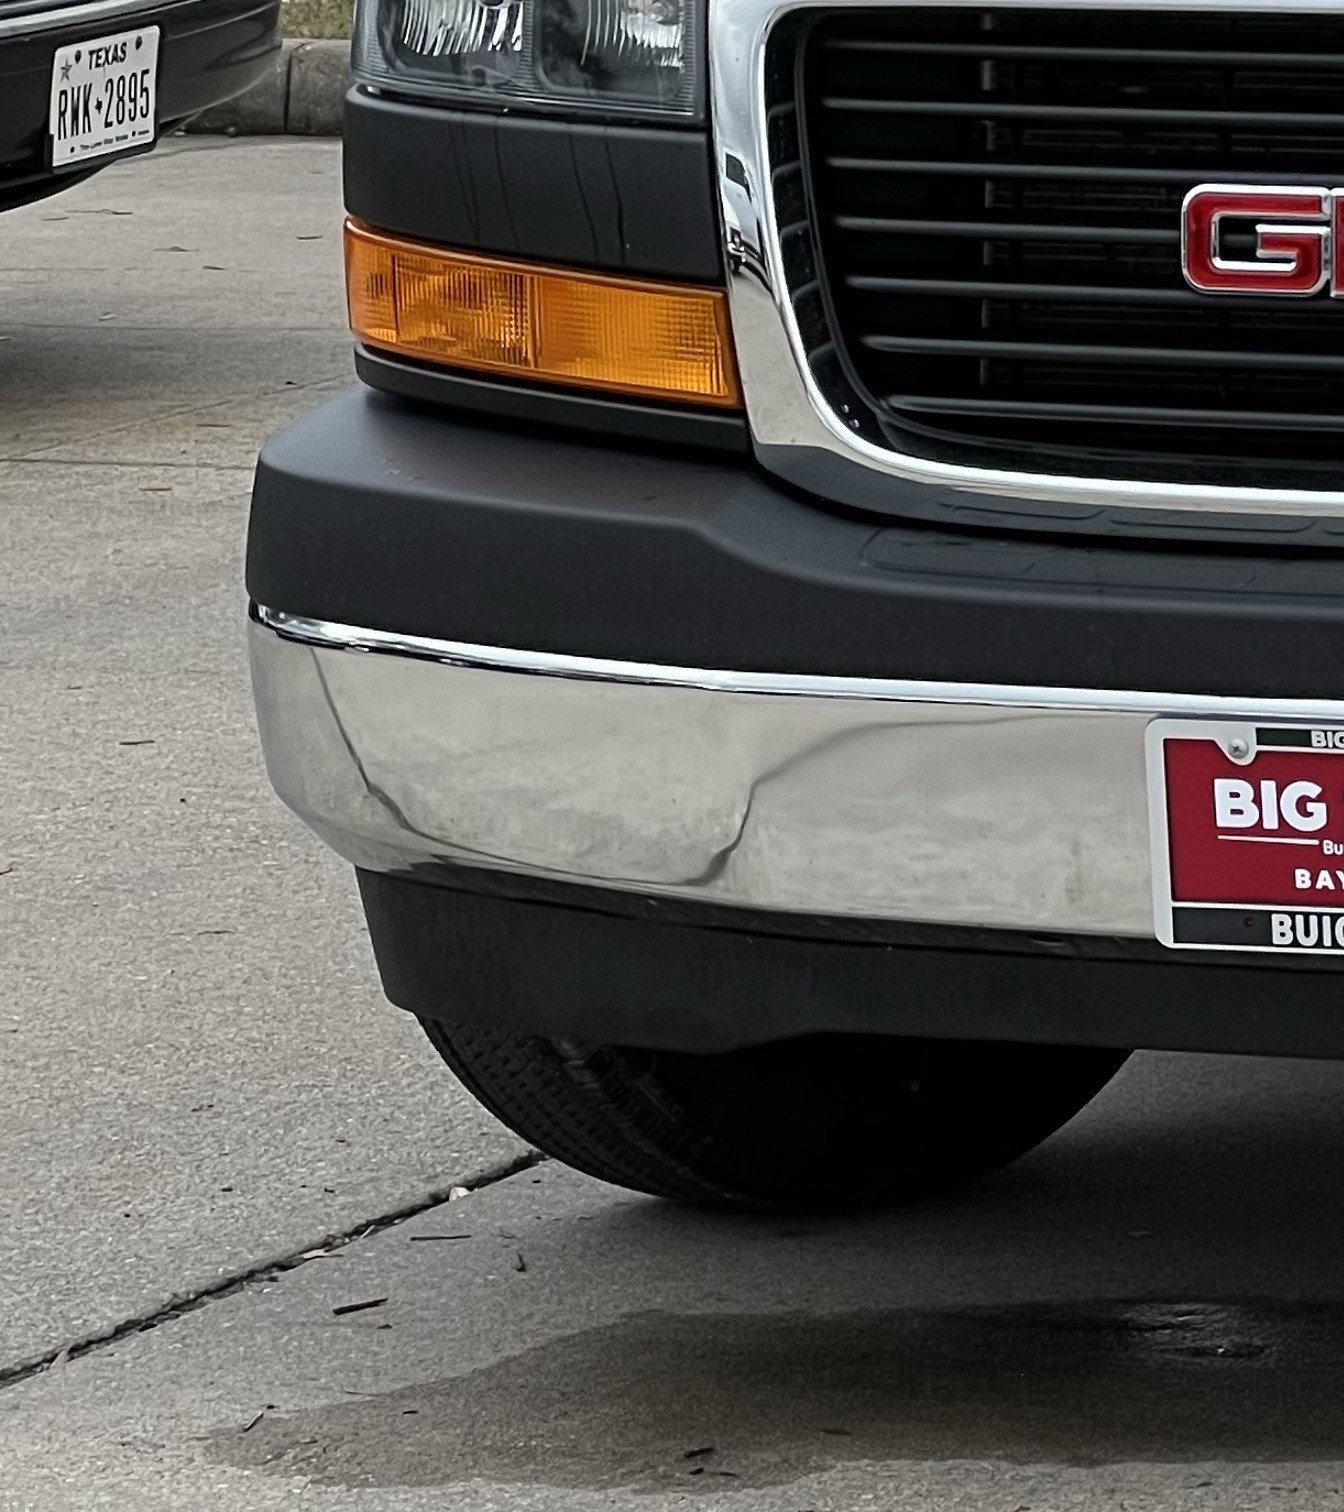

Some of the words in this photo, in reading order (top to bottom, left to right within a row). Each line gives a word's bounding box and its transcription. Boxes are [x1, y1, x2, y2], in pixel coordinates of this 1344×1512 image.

[88, 41, 128, 70] TEXAS
[104, 68, 151, 129] 2895
[1213, 778, 1328, 831] BIG
